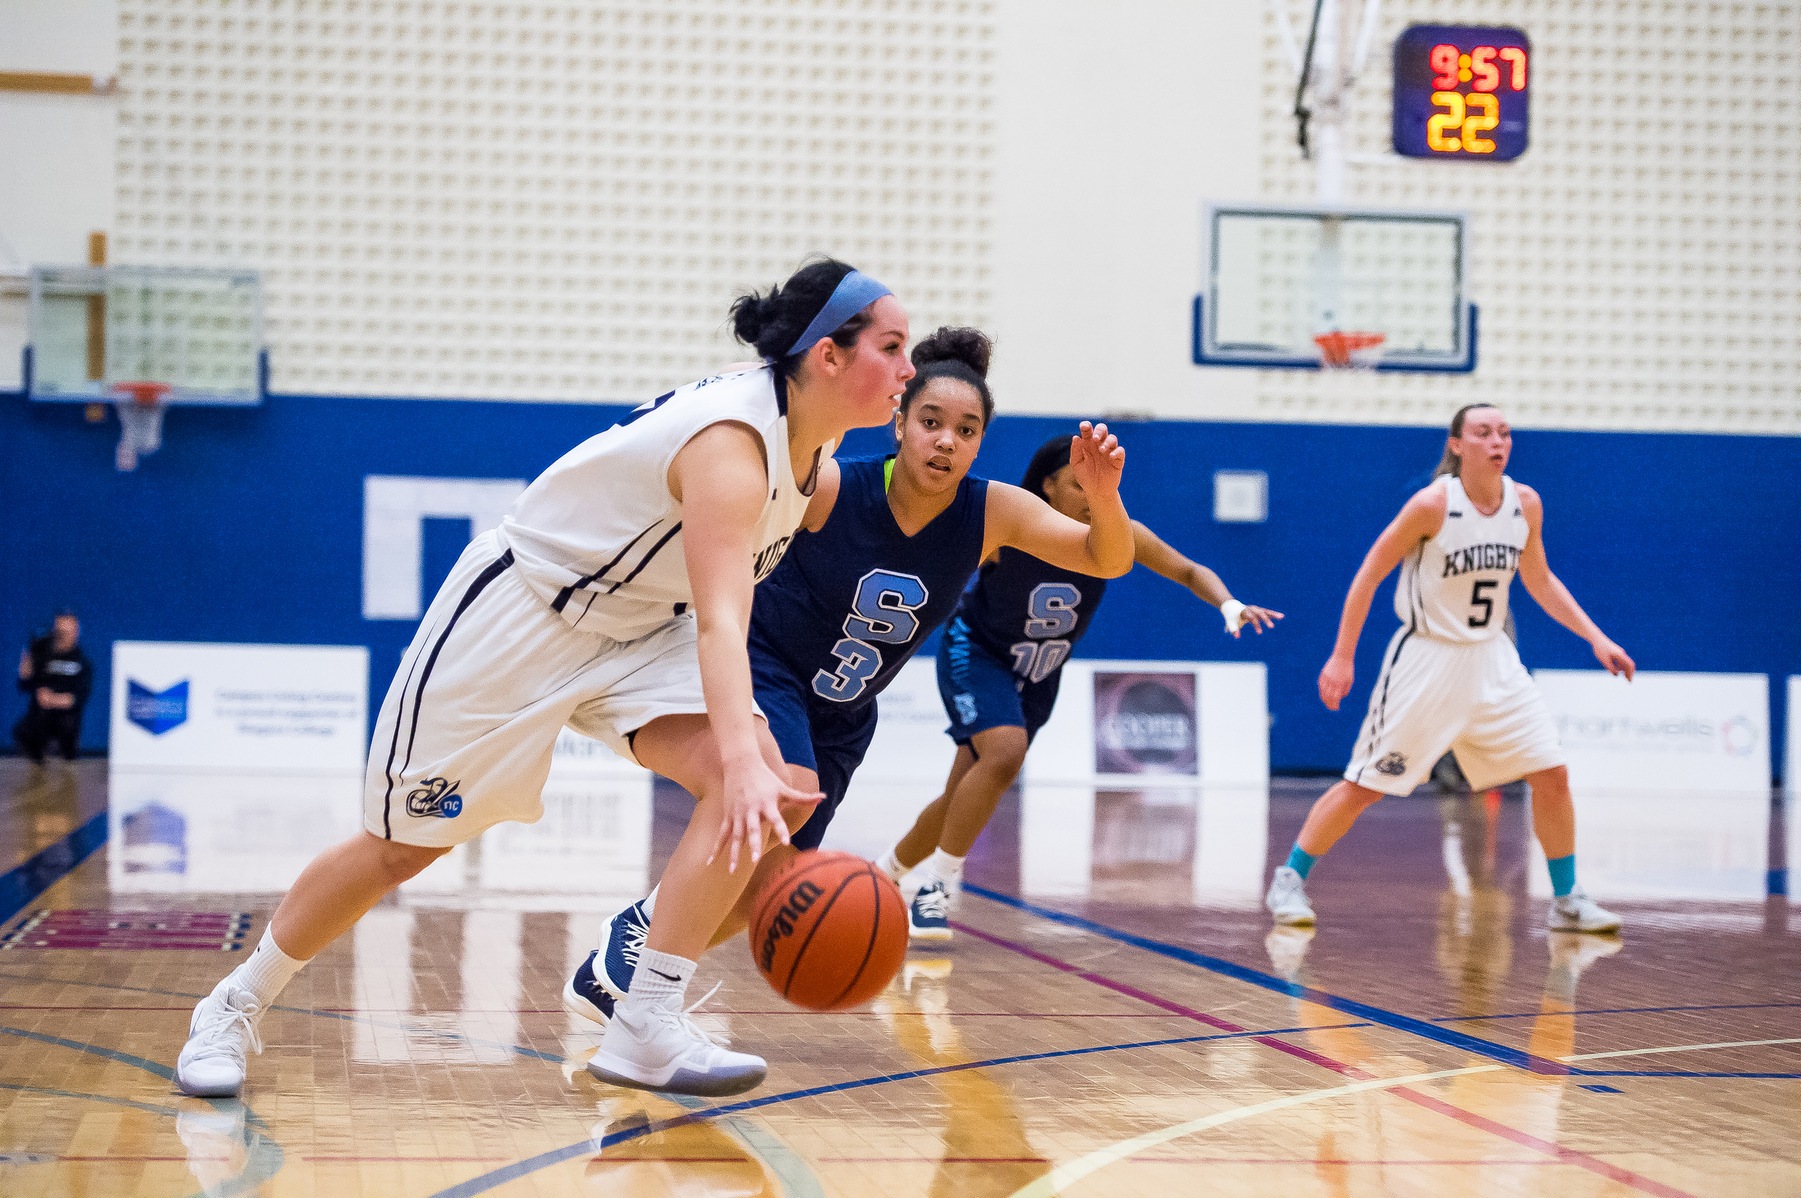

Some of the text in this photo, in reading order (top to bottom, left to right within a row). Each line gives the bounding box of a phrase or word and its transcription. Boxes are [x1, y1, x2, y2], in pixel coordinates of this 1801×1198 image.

[1429, 44, 1527, 92] 9:57
[1427, 91, 1500, 153] 22
[842, 568, 929, 644] S
[1024, 582, 1081, 639] S
[1468, 580, 1498, 628] 5
[811, 637, 883, 702] 3
